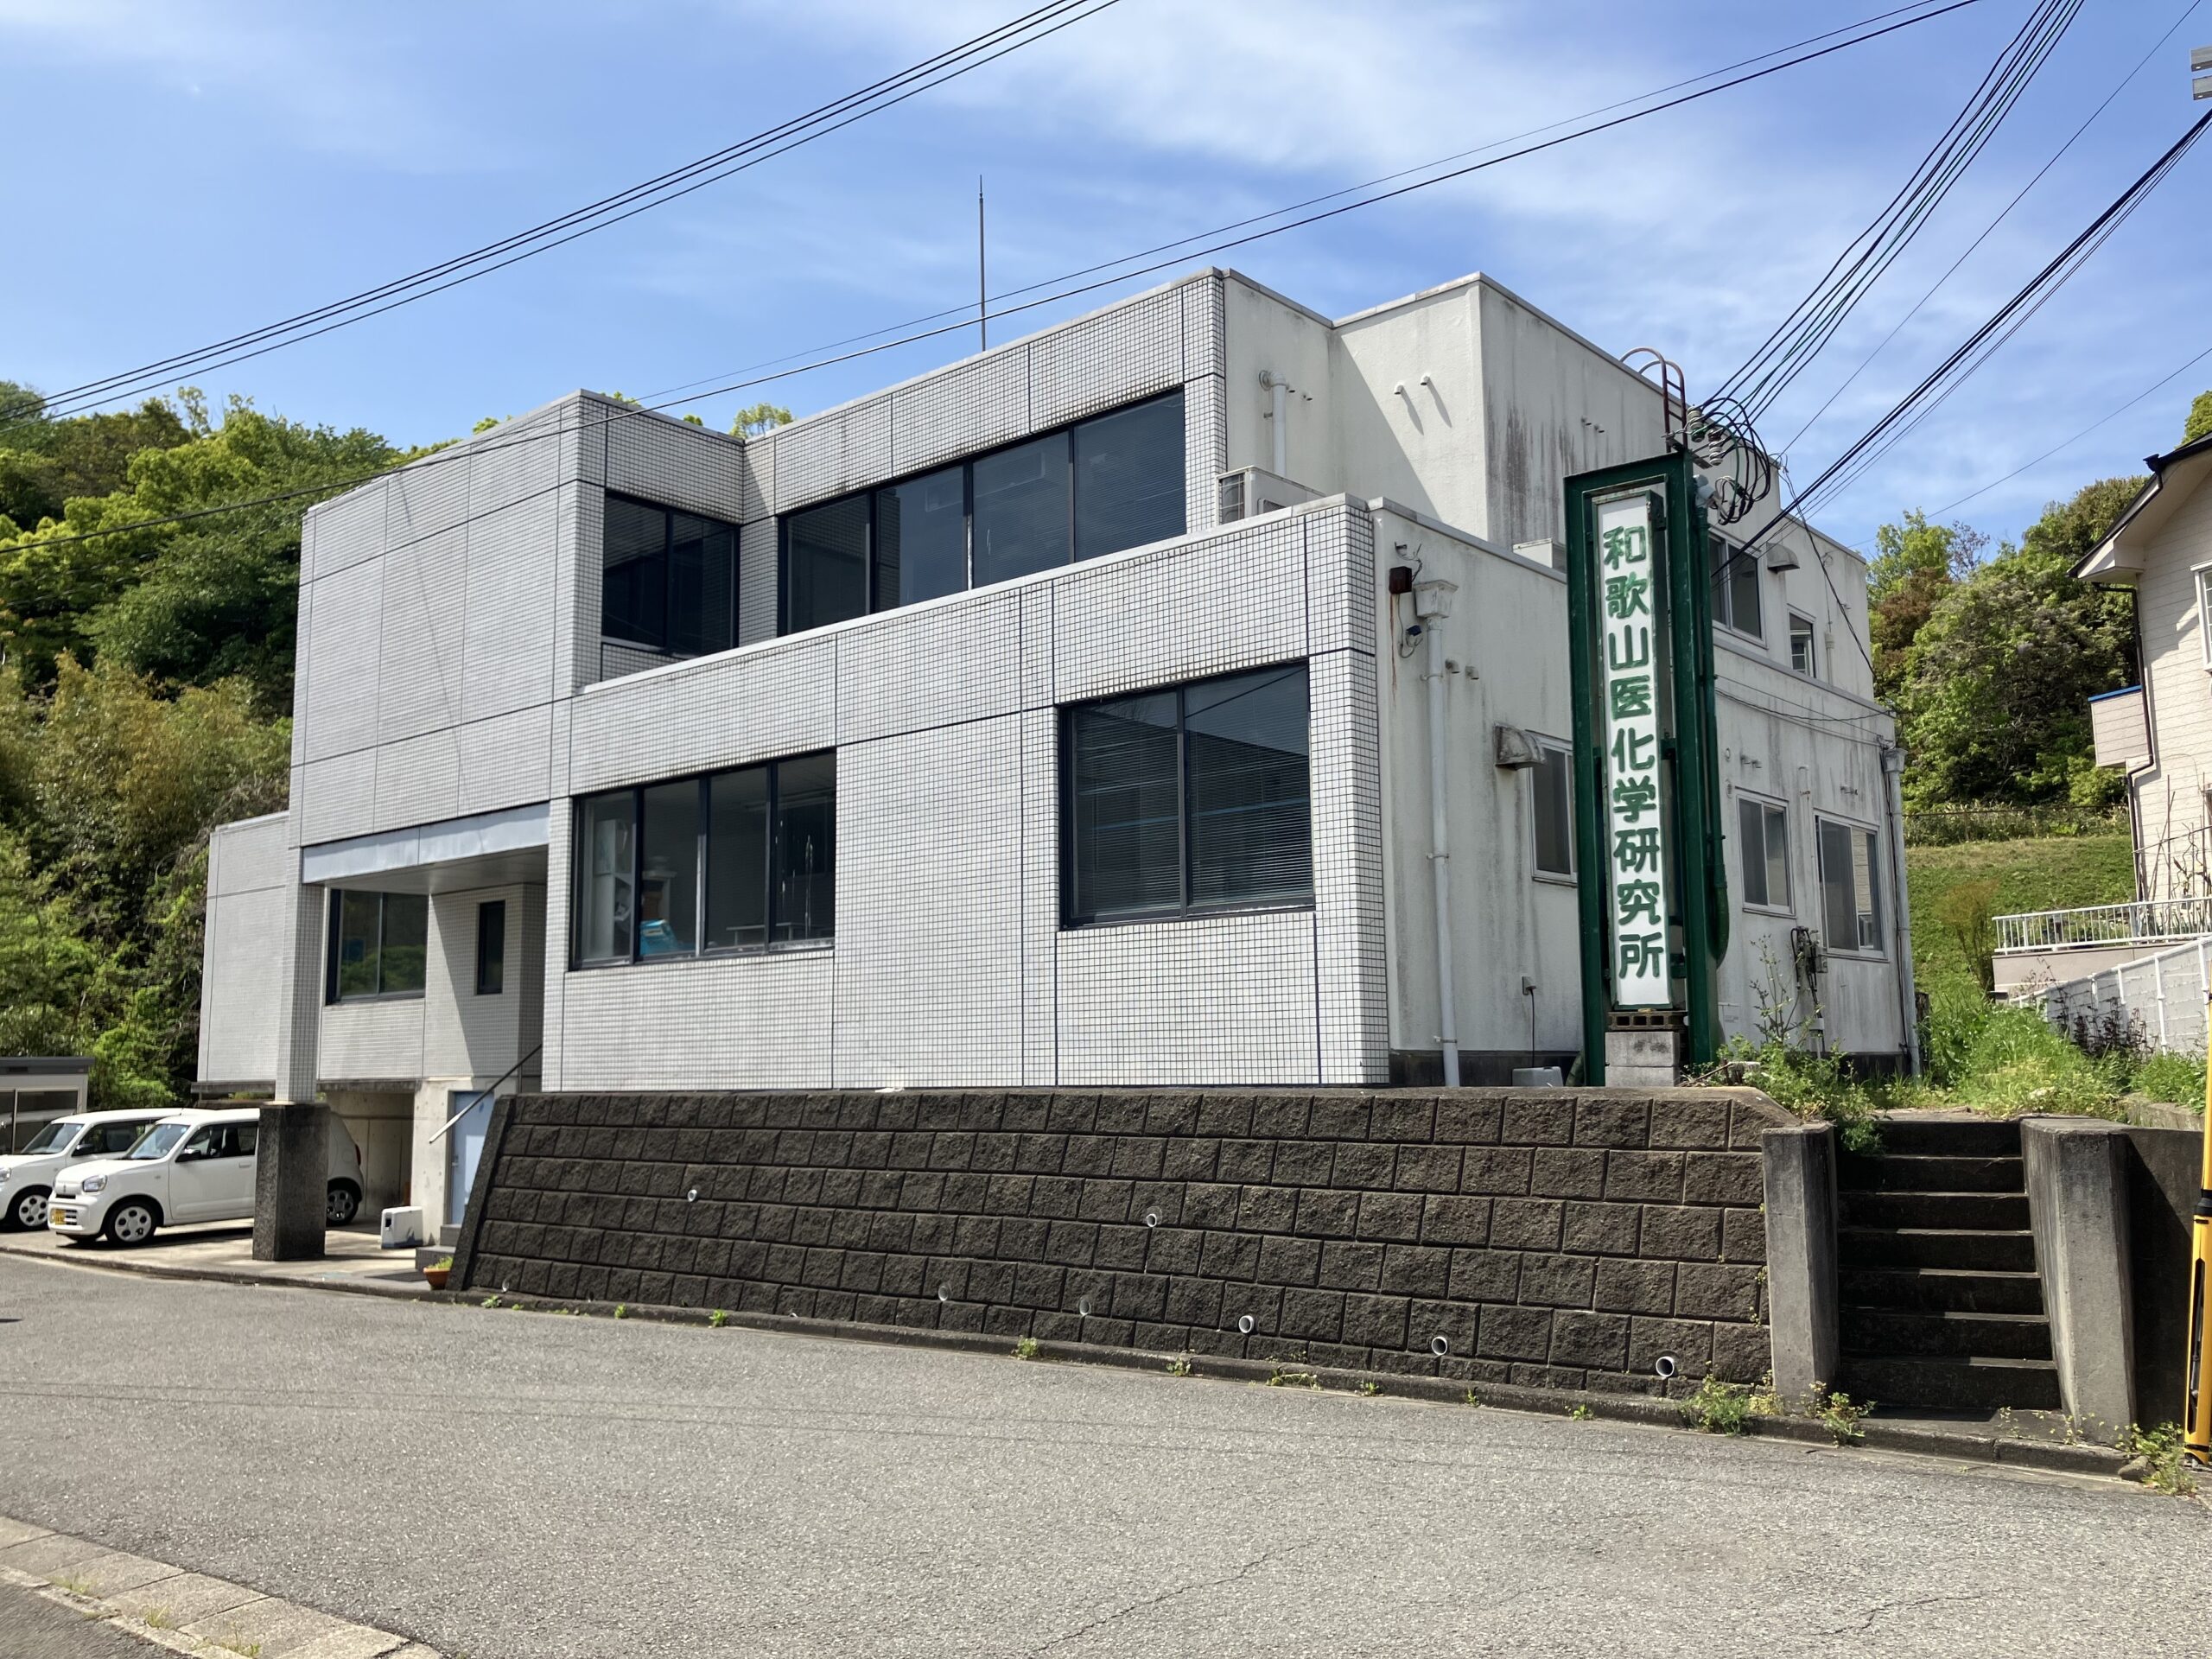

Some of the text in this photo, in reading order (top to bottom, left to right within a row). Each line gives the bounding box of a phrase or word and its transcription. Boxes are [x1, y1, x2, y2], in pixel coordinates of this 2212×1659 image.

[1603, 525, 1664, 979] 和歌山医化学研究所
